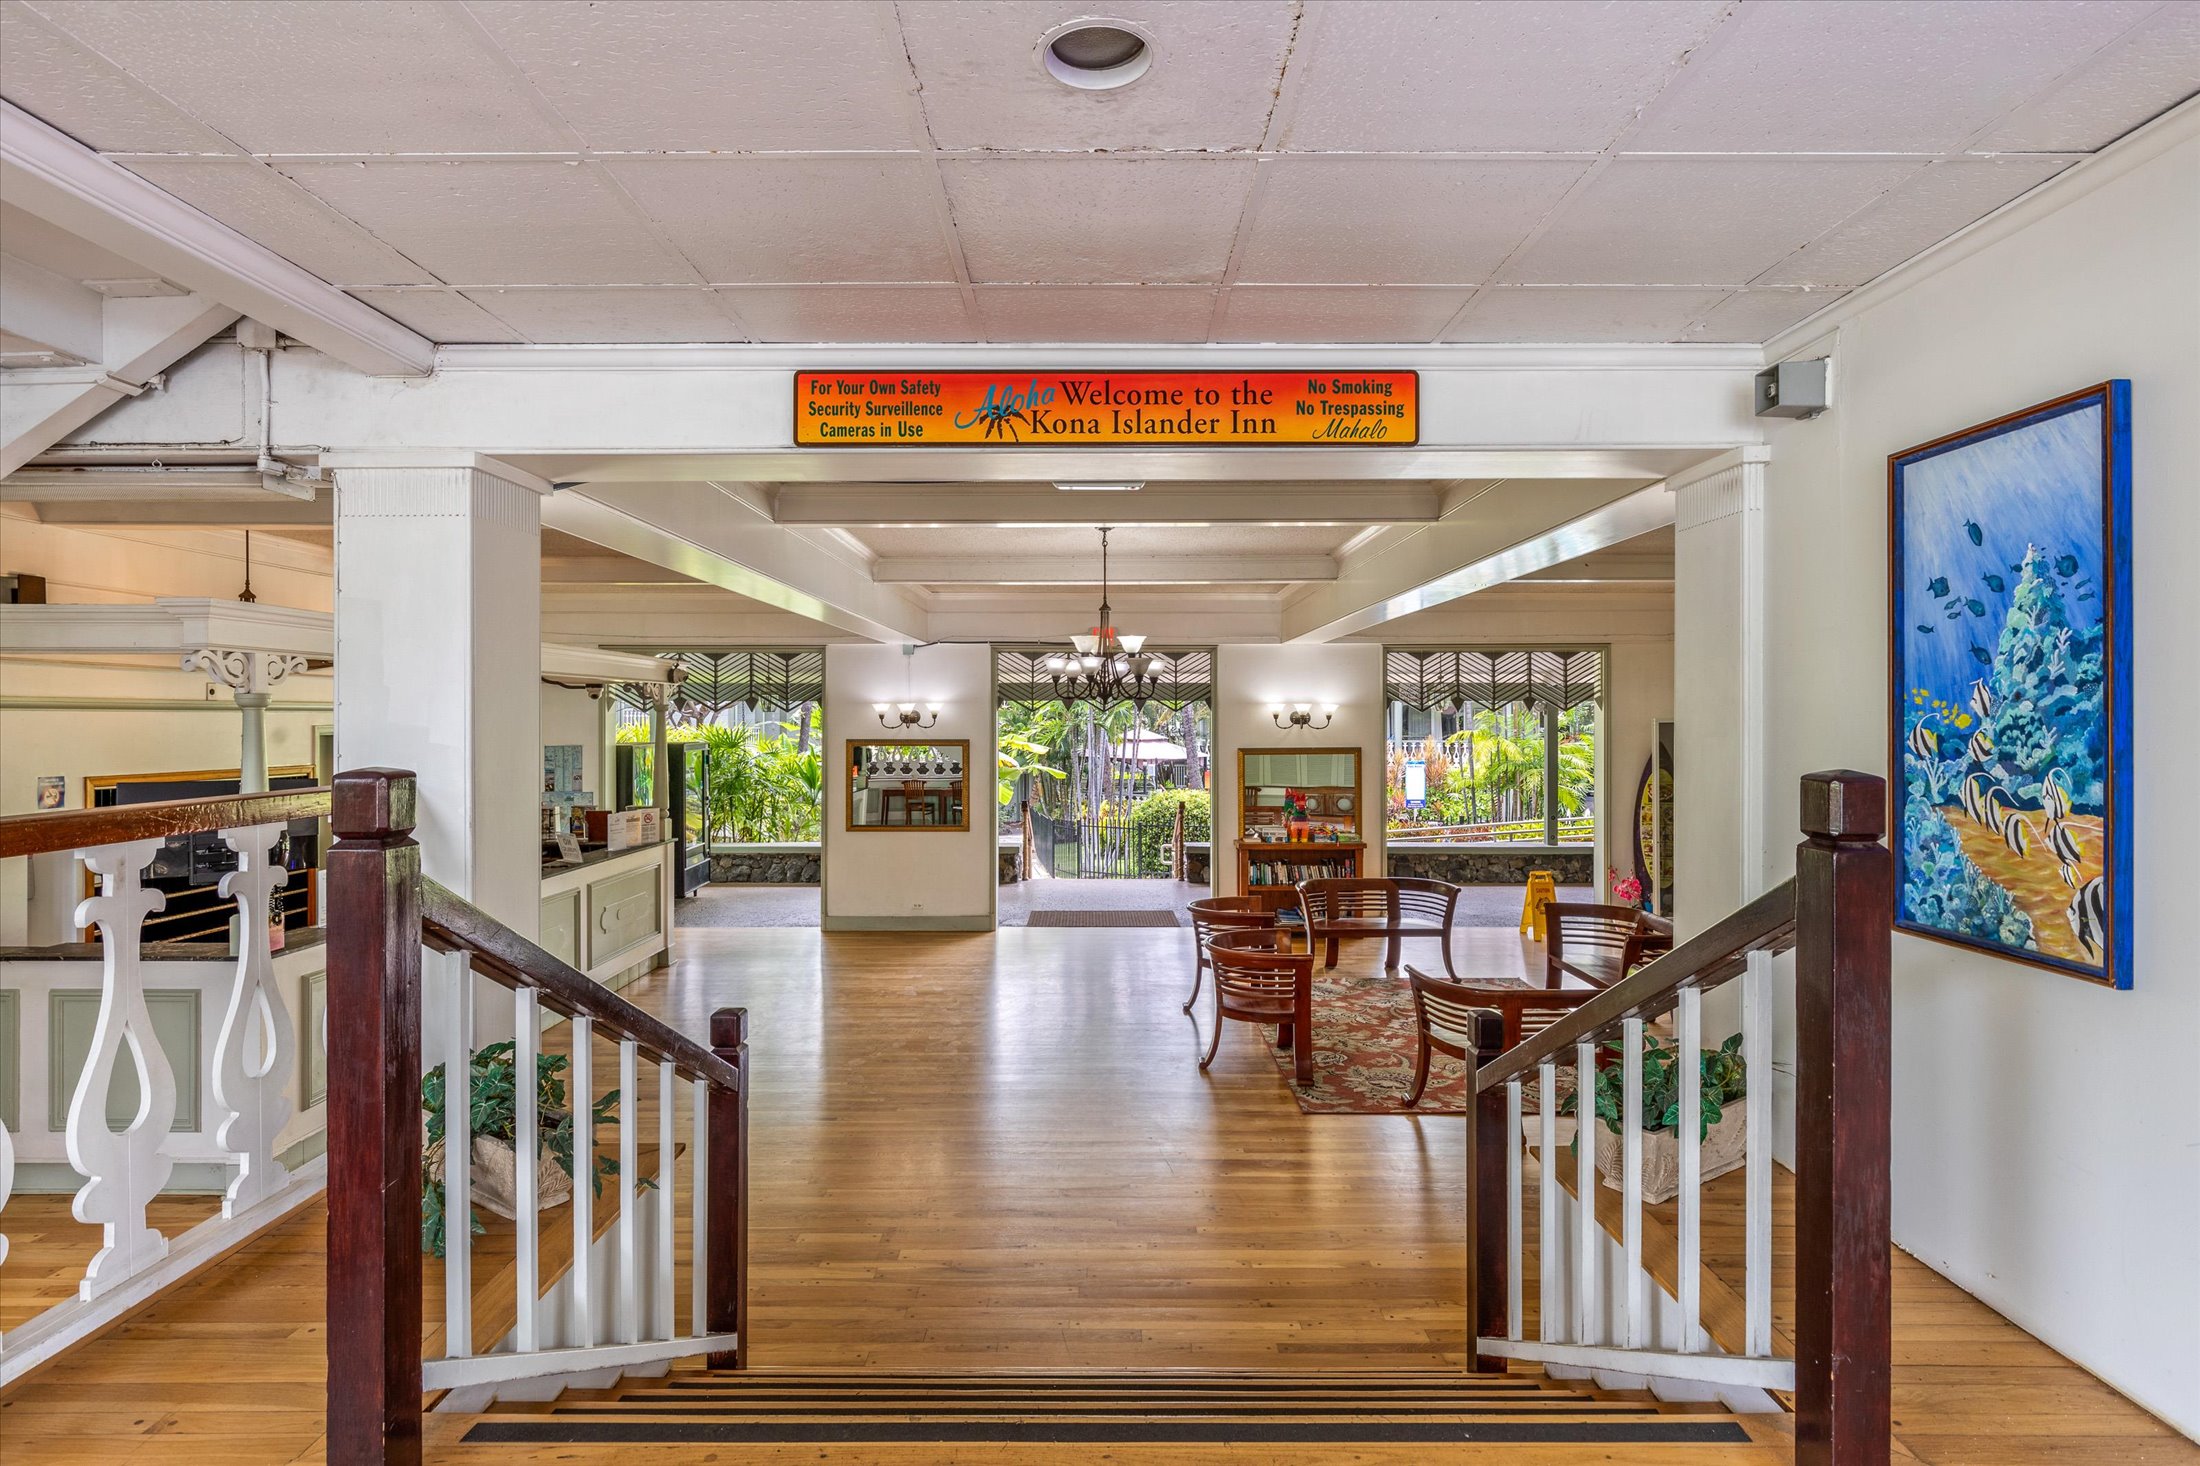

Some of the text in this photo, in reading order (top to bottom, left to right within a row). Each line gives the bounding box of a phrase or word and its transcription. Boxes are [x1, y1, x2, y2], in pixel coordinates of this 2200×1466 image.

[810, 379, 941, 397] For Your Own Safety
[1059, 379, 1273, 406] Welcome to the
[1308, 379, 1393, 397] No Smoking
[808, 401, 943, 418] Security Surveillence
[954, 378, 1056, 429] Aloha
[1296, 401, 1405, 418] No Trespassing
[820, 422, 923, 437] Cameras in Use
[1030, 408, 1277, 435] Kona Islander Inn
[1312, 418, 1388, 440] Mahalo
